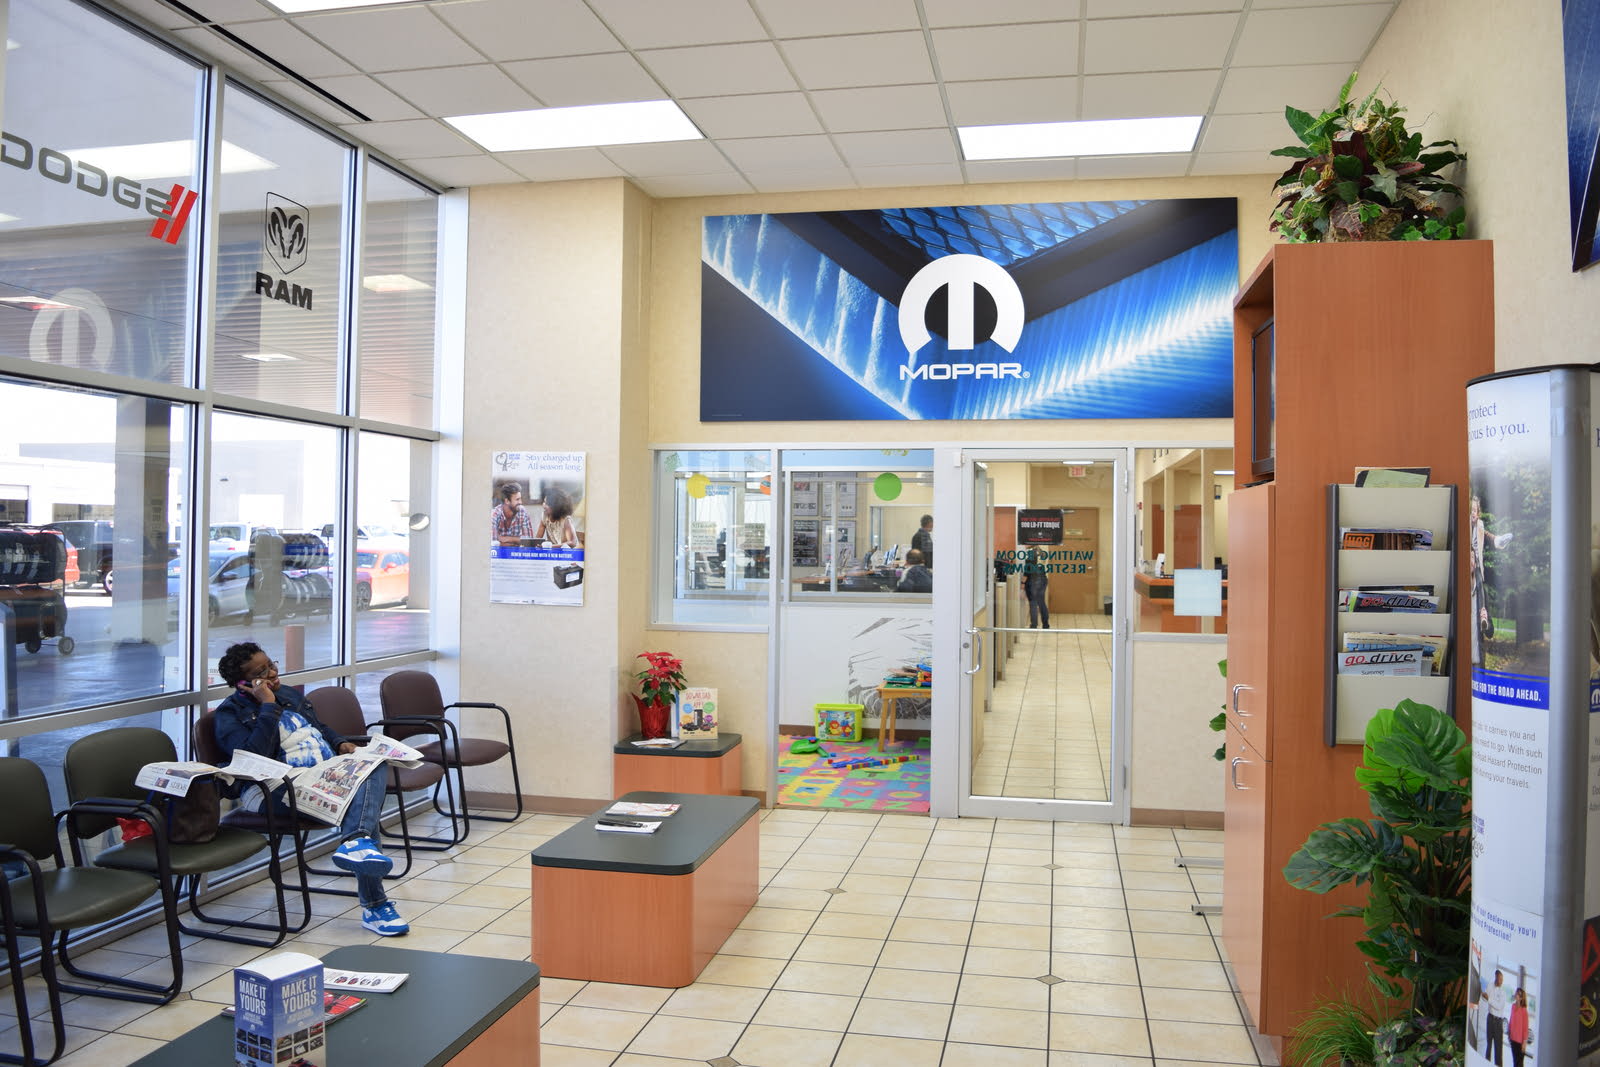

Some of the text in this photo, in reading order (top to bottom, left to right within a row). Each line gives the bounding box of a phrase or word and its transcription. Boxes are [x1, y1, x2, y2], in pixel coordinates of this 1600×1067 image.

[0, 131, 173, 220] DODGE
[255, 271, 313, 311] RAM
[899, 363, 1023, 380] MOPAR
[1486, 425, 1497, 438] to
[1500, 423, 1530, 441] you.
[526, 454, 541, 462] Stay
[543, 453, 571, 463] charged
[1479, 682, 1487, 693] FOR
[1488, 684, 1497, 695] THE
[1498, 686, 1515, 698] ROAD
[1516, 688, 1541, 702] AHEAD.
[1509, 730, 1521, 739] you
[1522, 732, 1536, 741] and
[1507, 744, 1524, 756] With
[1526, 749, 1543, 759] such
[1488, 755, 1506, 768] Hazard
[1507, 759, 1542, 775] Protection
[1492, 774, 1505, 783] your
[1518, 926, 1537, 939] you'll
[239, 979, 266, 1000] MAKE IT
[281, 975, 317, 1000] MAKE IT
[239, 993, 266, 1016] YOURS
[282, 989, 317, 1014] YOURS
